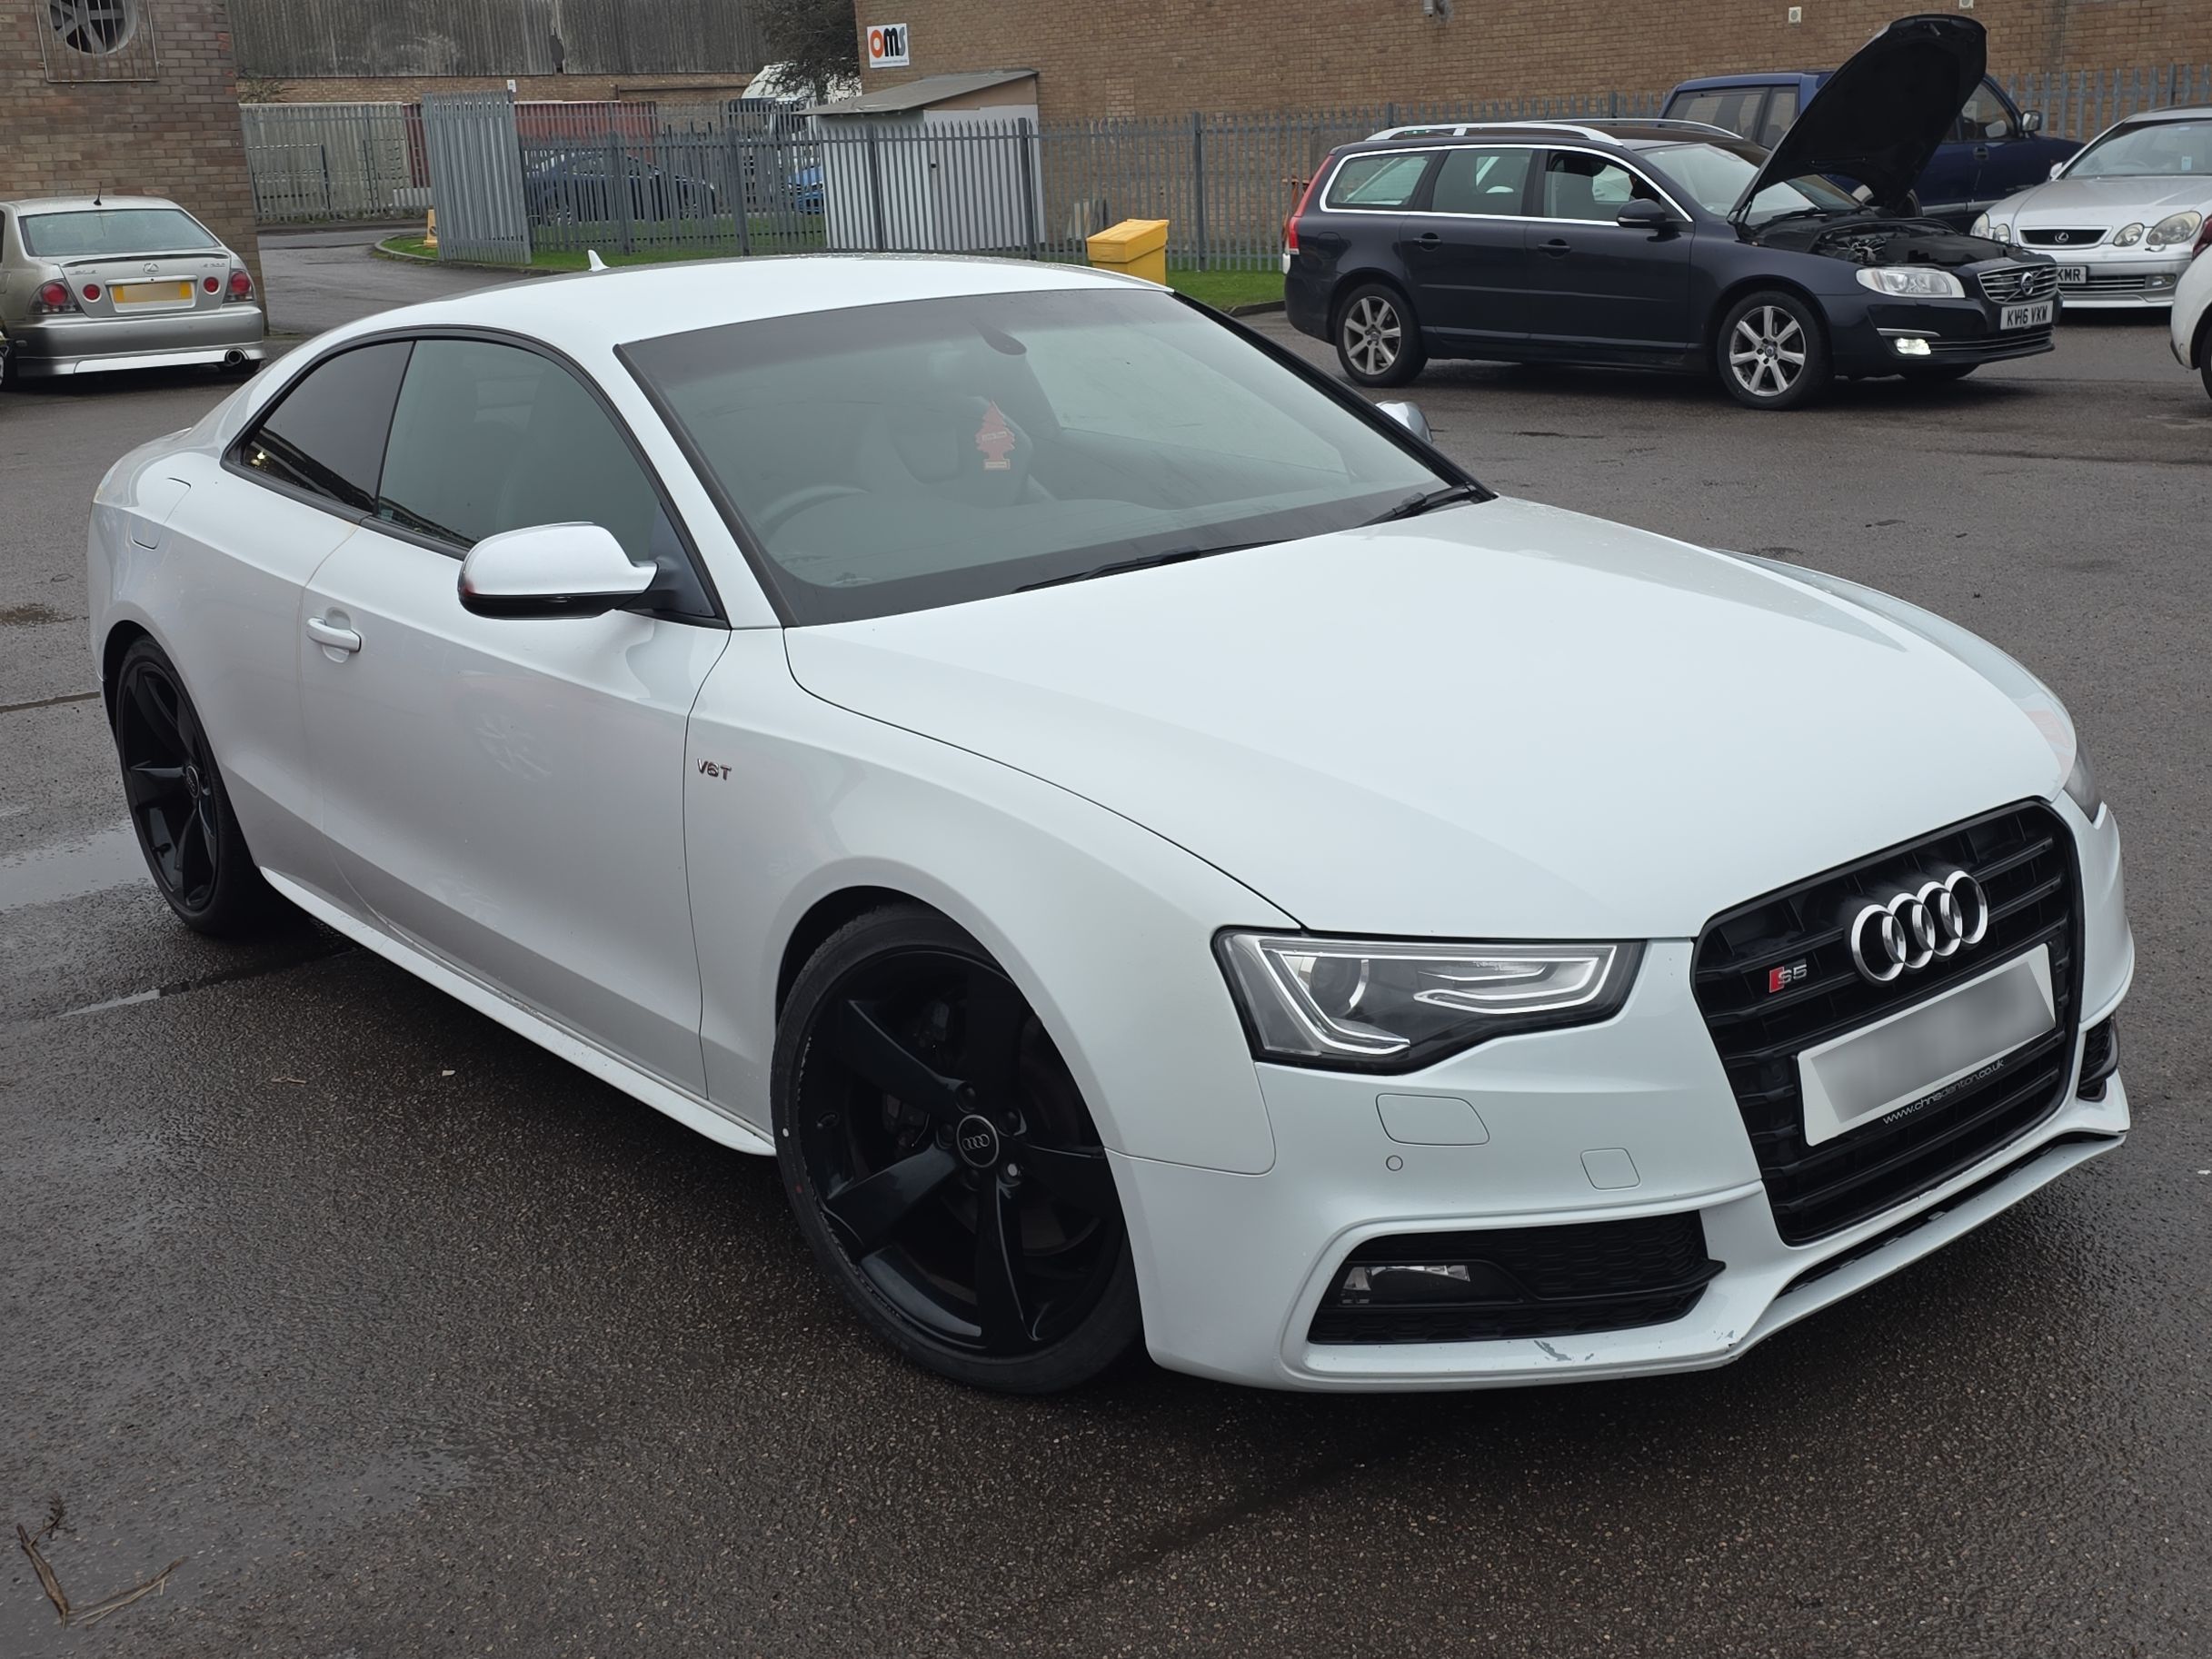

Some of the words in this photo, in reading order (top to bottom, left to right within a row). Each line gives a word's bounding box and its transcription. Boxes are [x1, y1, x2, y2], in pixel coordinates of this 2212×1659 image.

[697, 758, 732, 781] V6T
[1778, 963, 1808, 985] S5
[1882, 1058, 2005, 1125] www.chrisdenton.co.uk
